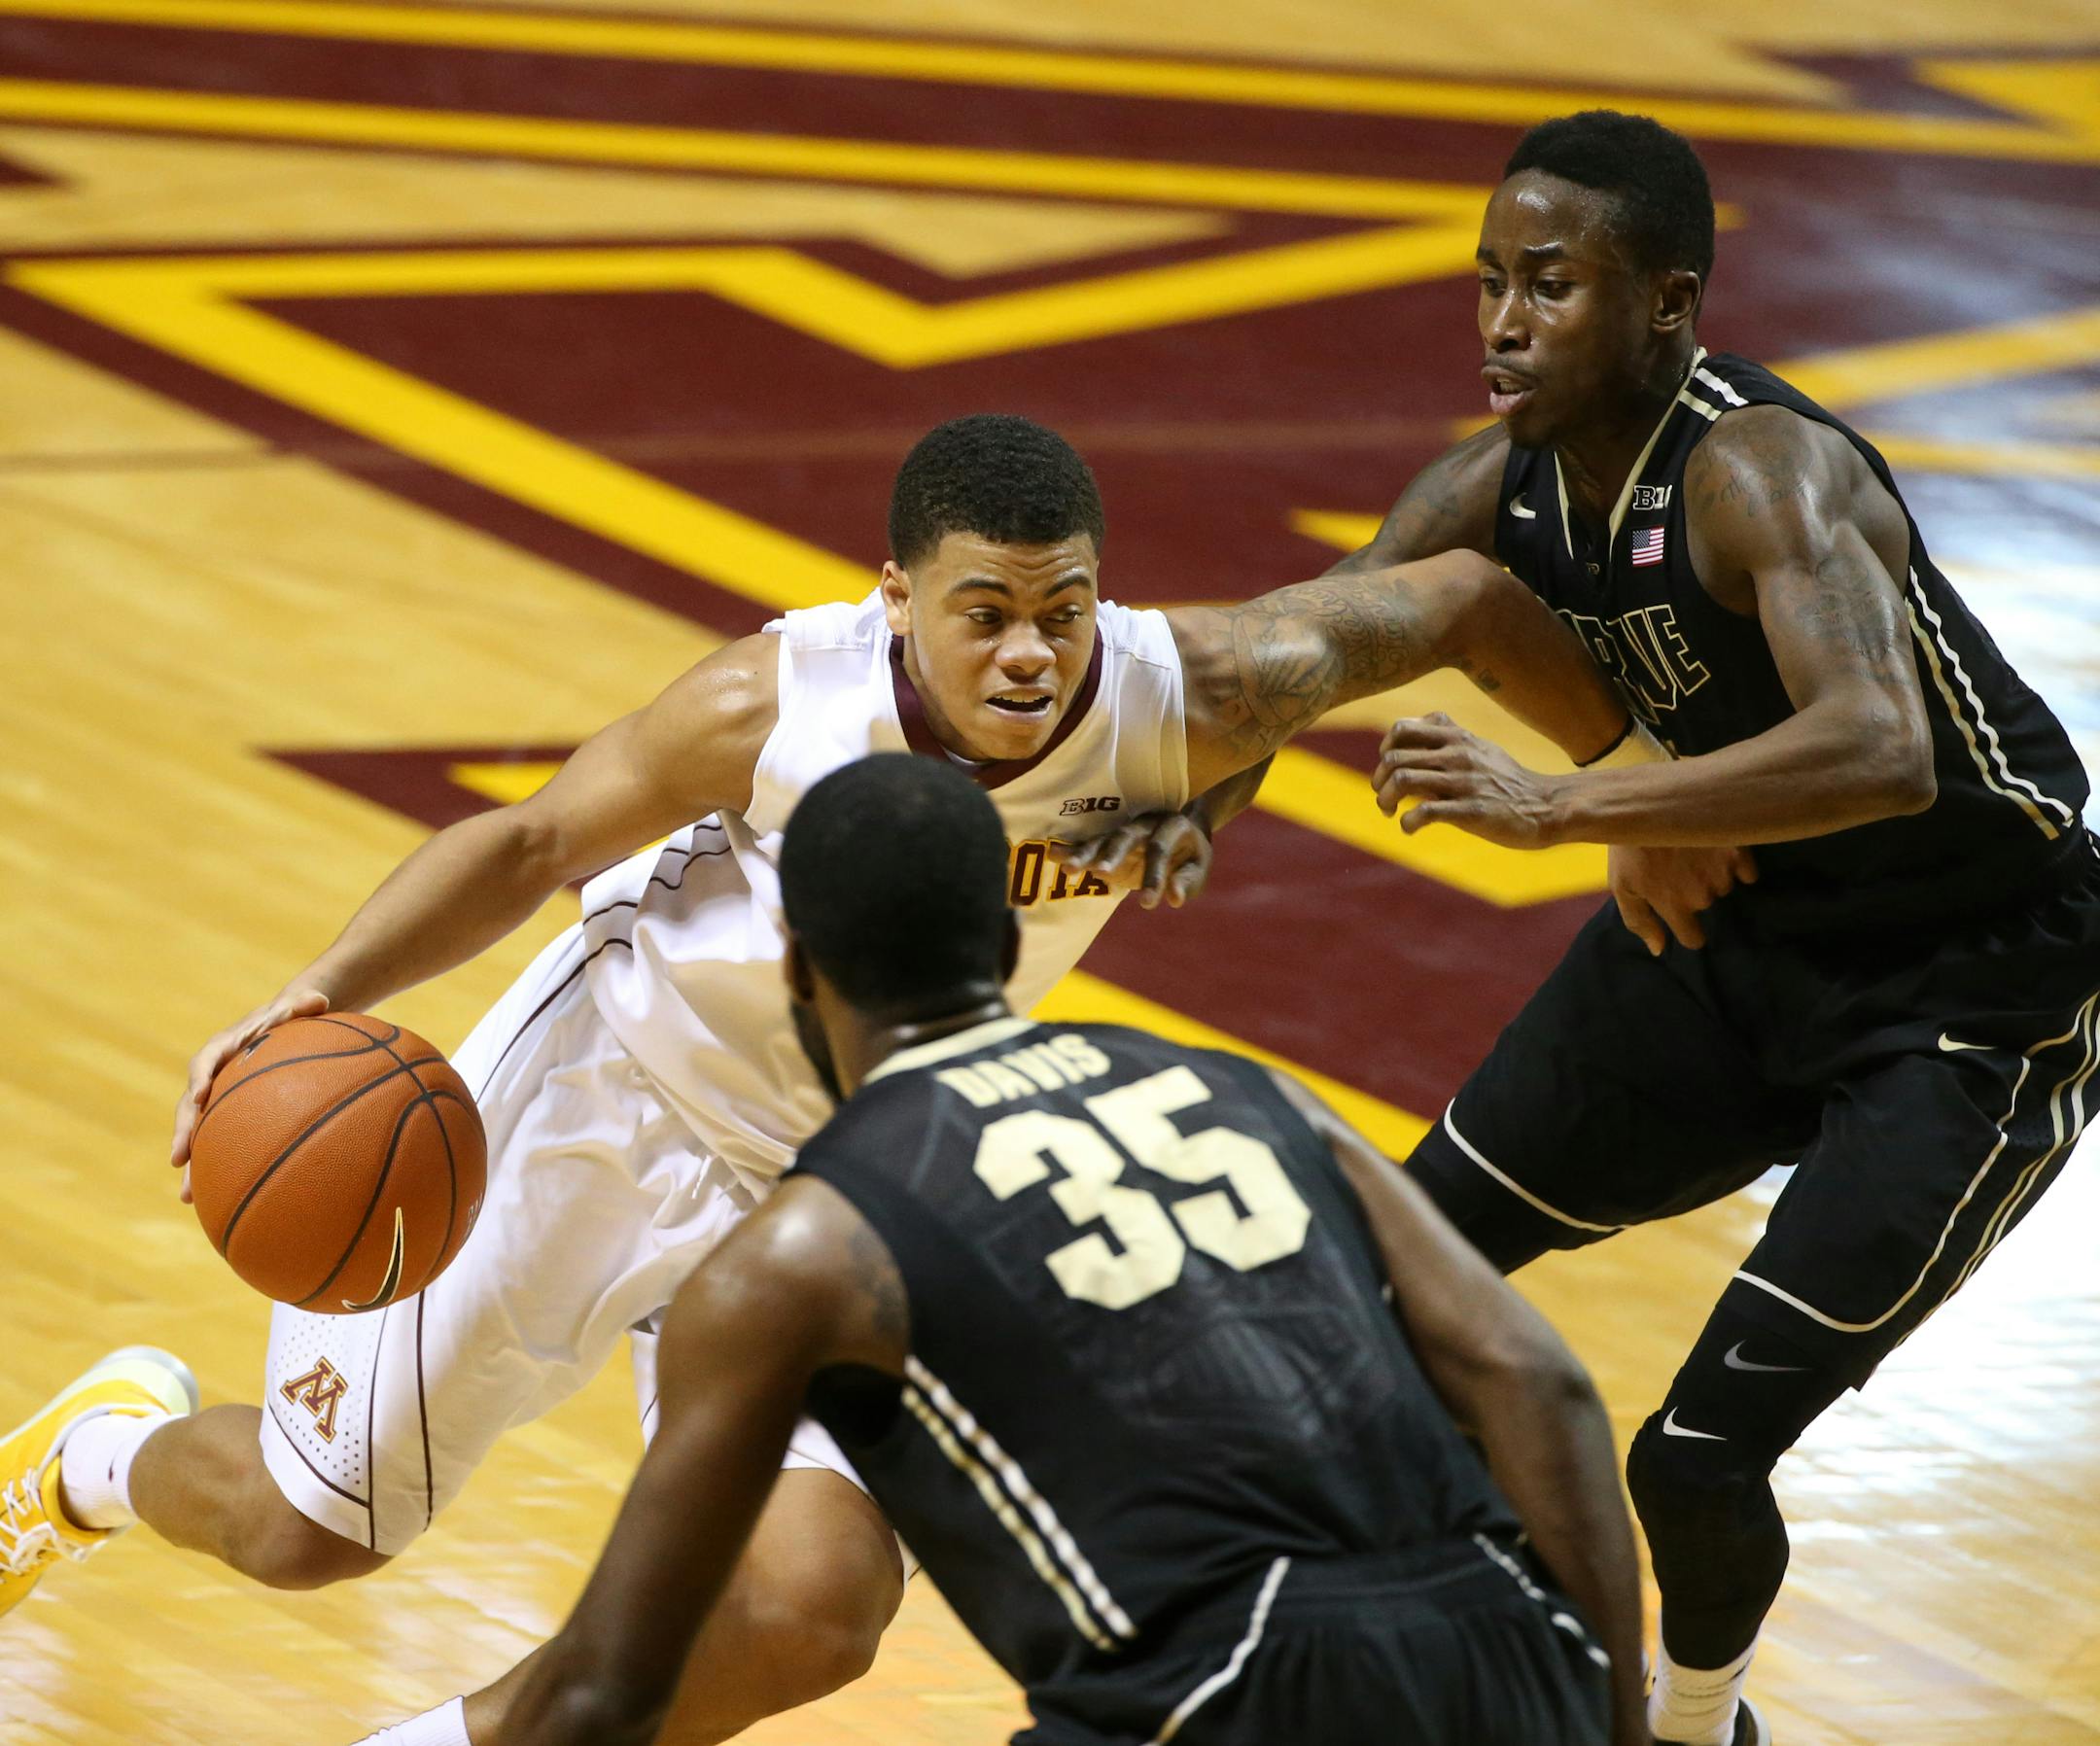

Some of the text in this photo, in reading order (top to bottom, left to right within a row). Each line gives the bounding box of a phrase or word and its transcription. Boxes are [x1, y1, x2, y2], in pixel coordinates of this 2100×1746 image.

[1005, 837, 1111, 909] OTA
[935, 1033, 1111, 1108] DAVIS
[973, 1065, 1312, 1310] 35
[279, 1355, 349, 1444] M
